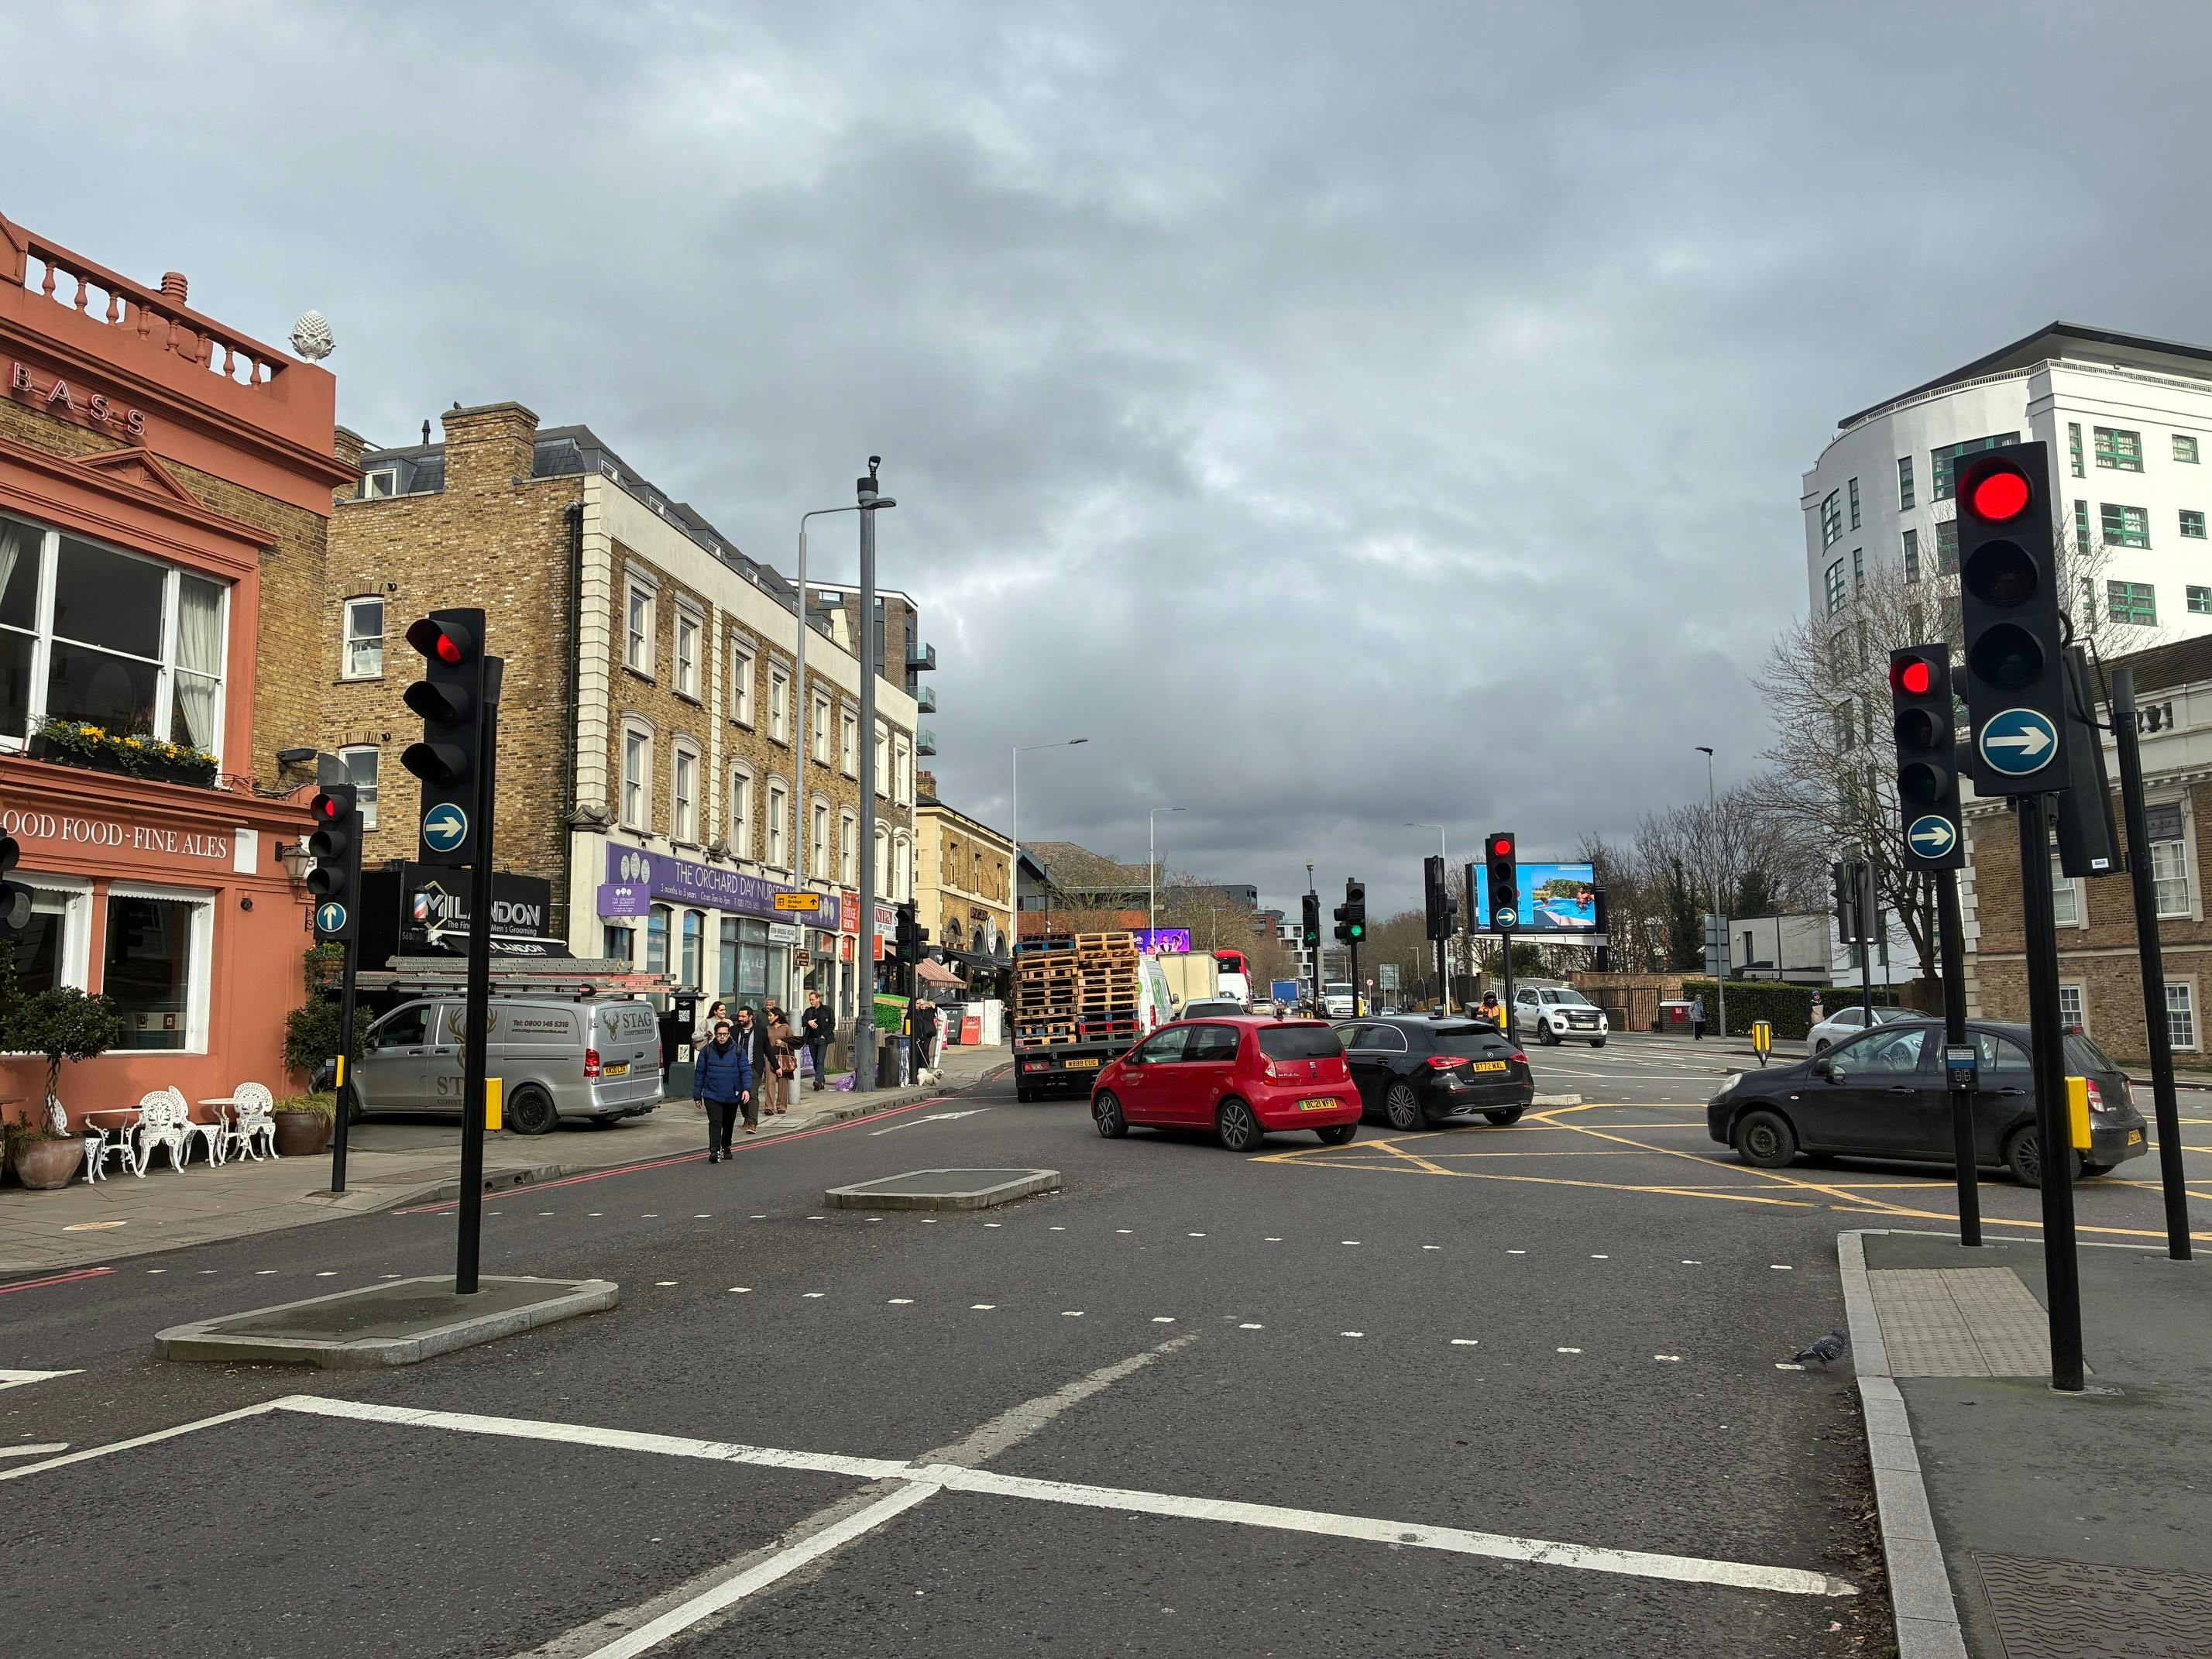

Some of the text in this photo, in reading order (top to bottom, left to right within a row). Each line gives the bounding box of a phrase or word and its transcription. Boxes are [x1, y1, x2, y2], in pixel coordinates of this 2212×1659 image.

[9, 362, 145, 435] BASS
[0, 810, 56, 838] OOD
[182, 833, 227, 858] ALES
[675, 862, 692, 885] THE
[696, 867, 737, 894] ORCHARD
[740, 877, 755, 898] DAY
[661, 883, 664, 892] 3
[664, 885, 678, 895] months
[678, 887, 682, 895] to
[683, 888, 686, 896] 5
[687, 891, 696, 899] years
[701, 891, 711, 902] Open
[426, 893, 541, 926] MILNDON
[876, 908, 892, 925] NIPA
[510, 926, 538, 936] Grooming
[623, 1012, 651, 1029] STAG
[1475, 1063, 1492, 1071] BT72
[438, 1077, 465, 1095] ST
